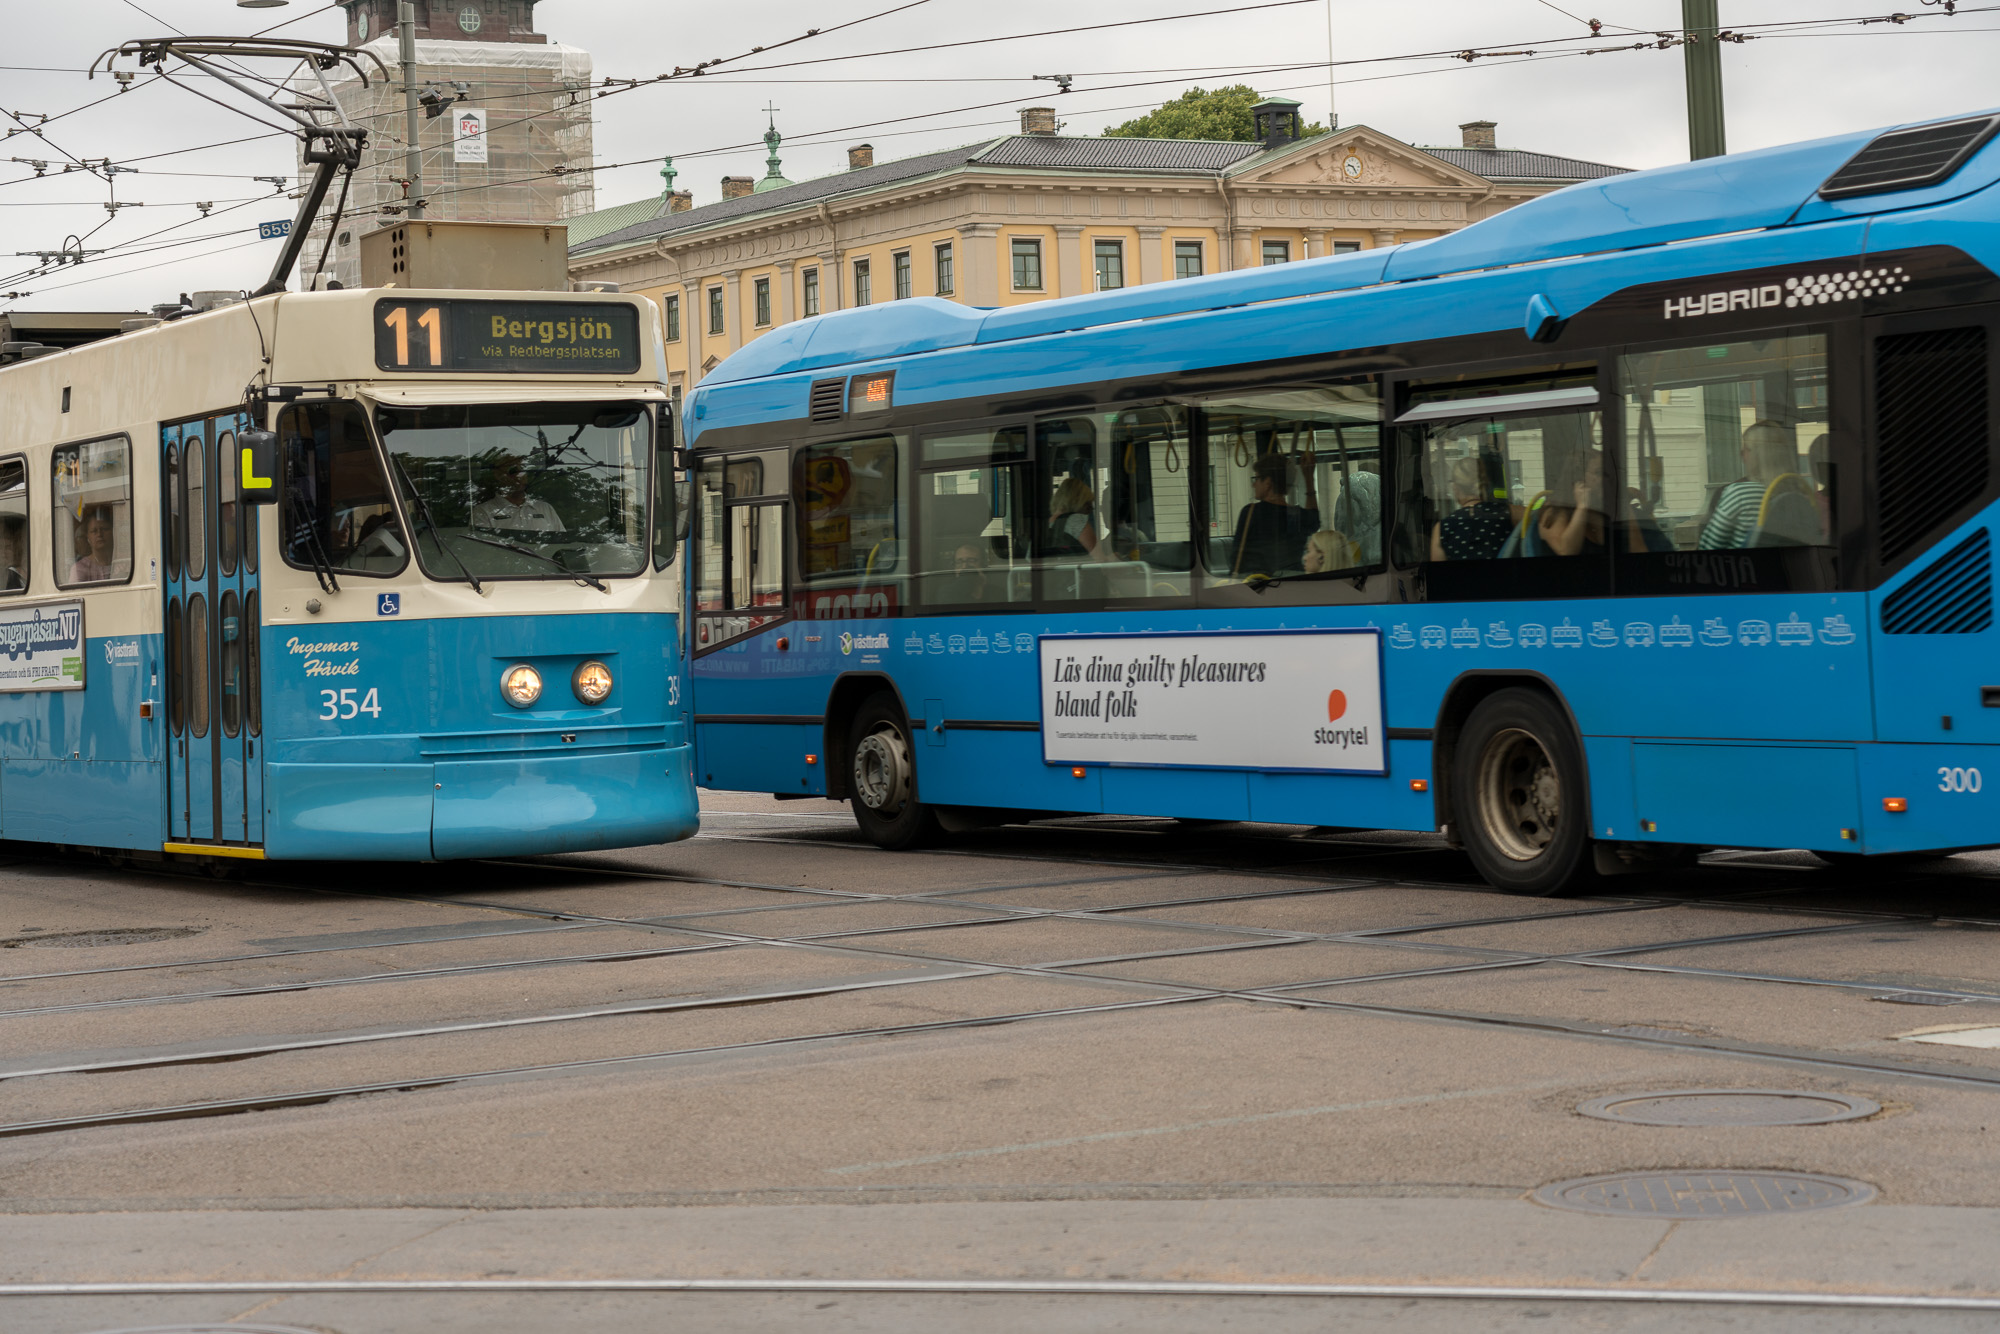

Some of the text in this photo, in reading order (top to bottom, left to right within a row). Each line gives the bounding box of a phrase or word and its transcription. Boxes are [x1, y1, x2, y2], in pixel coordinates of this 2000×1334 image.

[261, 221, 292, 237] 659
[1664, 285, 1781, 319] HYBRID
[384, 307, 442, 365] 11
[491, 315, 612, 344] Bergsjön
[482, 345, 621, 359] via Redbergsplatsen
[286, 636, 360, 659] Ingemar
[303, 658, 360, 677] Håvik
[1053, 654, 1267, 688] Läs dina guilty pleasures
[320, 687, 382, 720] 354
[1055, 690, 1137, 722] bland folk
[1313, 726, 1368, 750] storytel
[1937, 766, 1982, 793] 300
